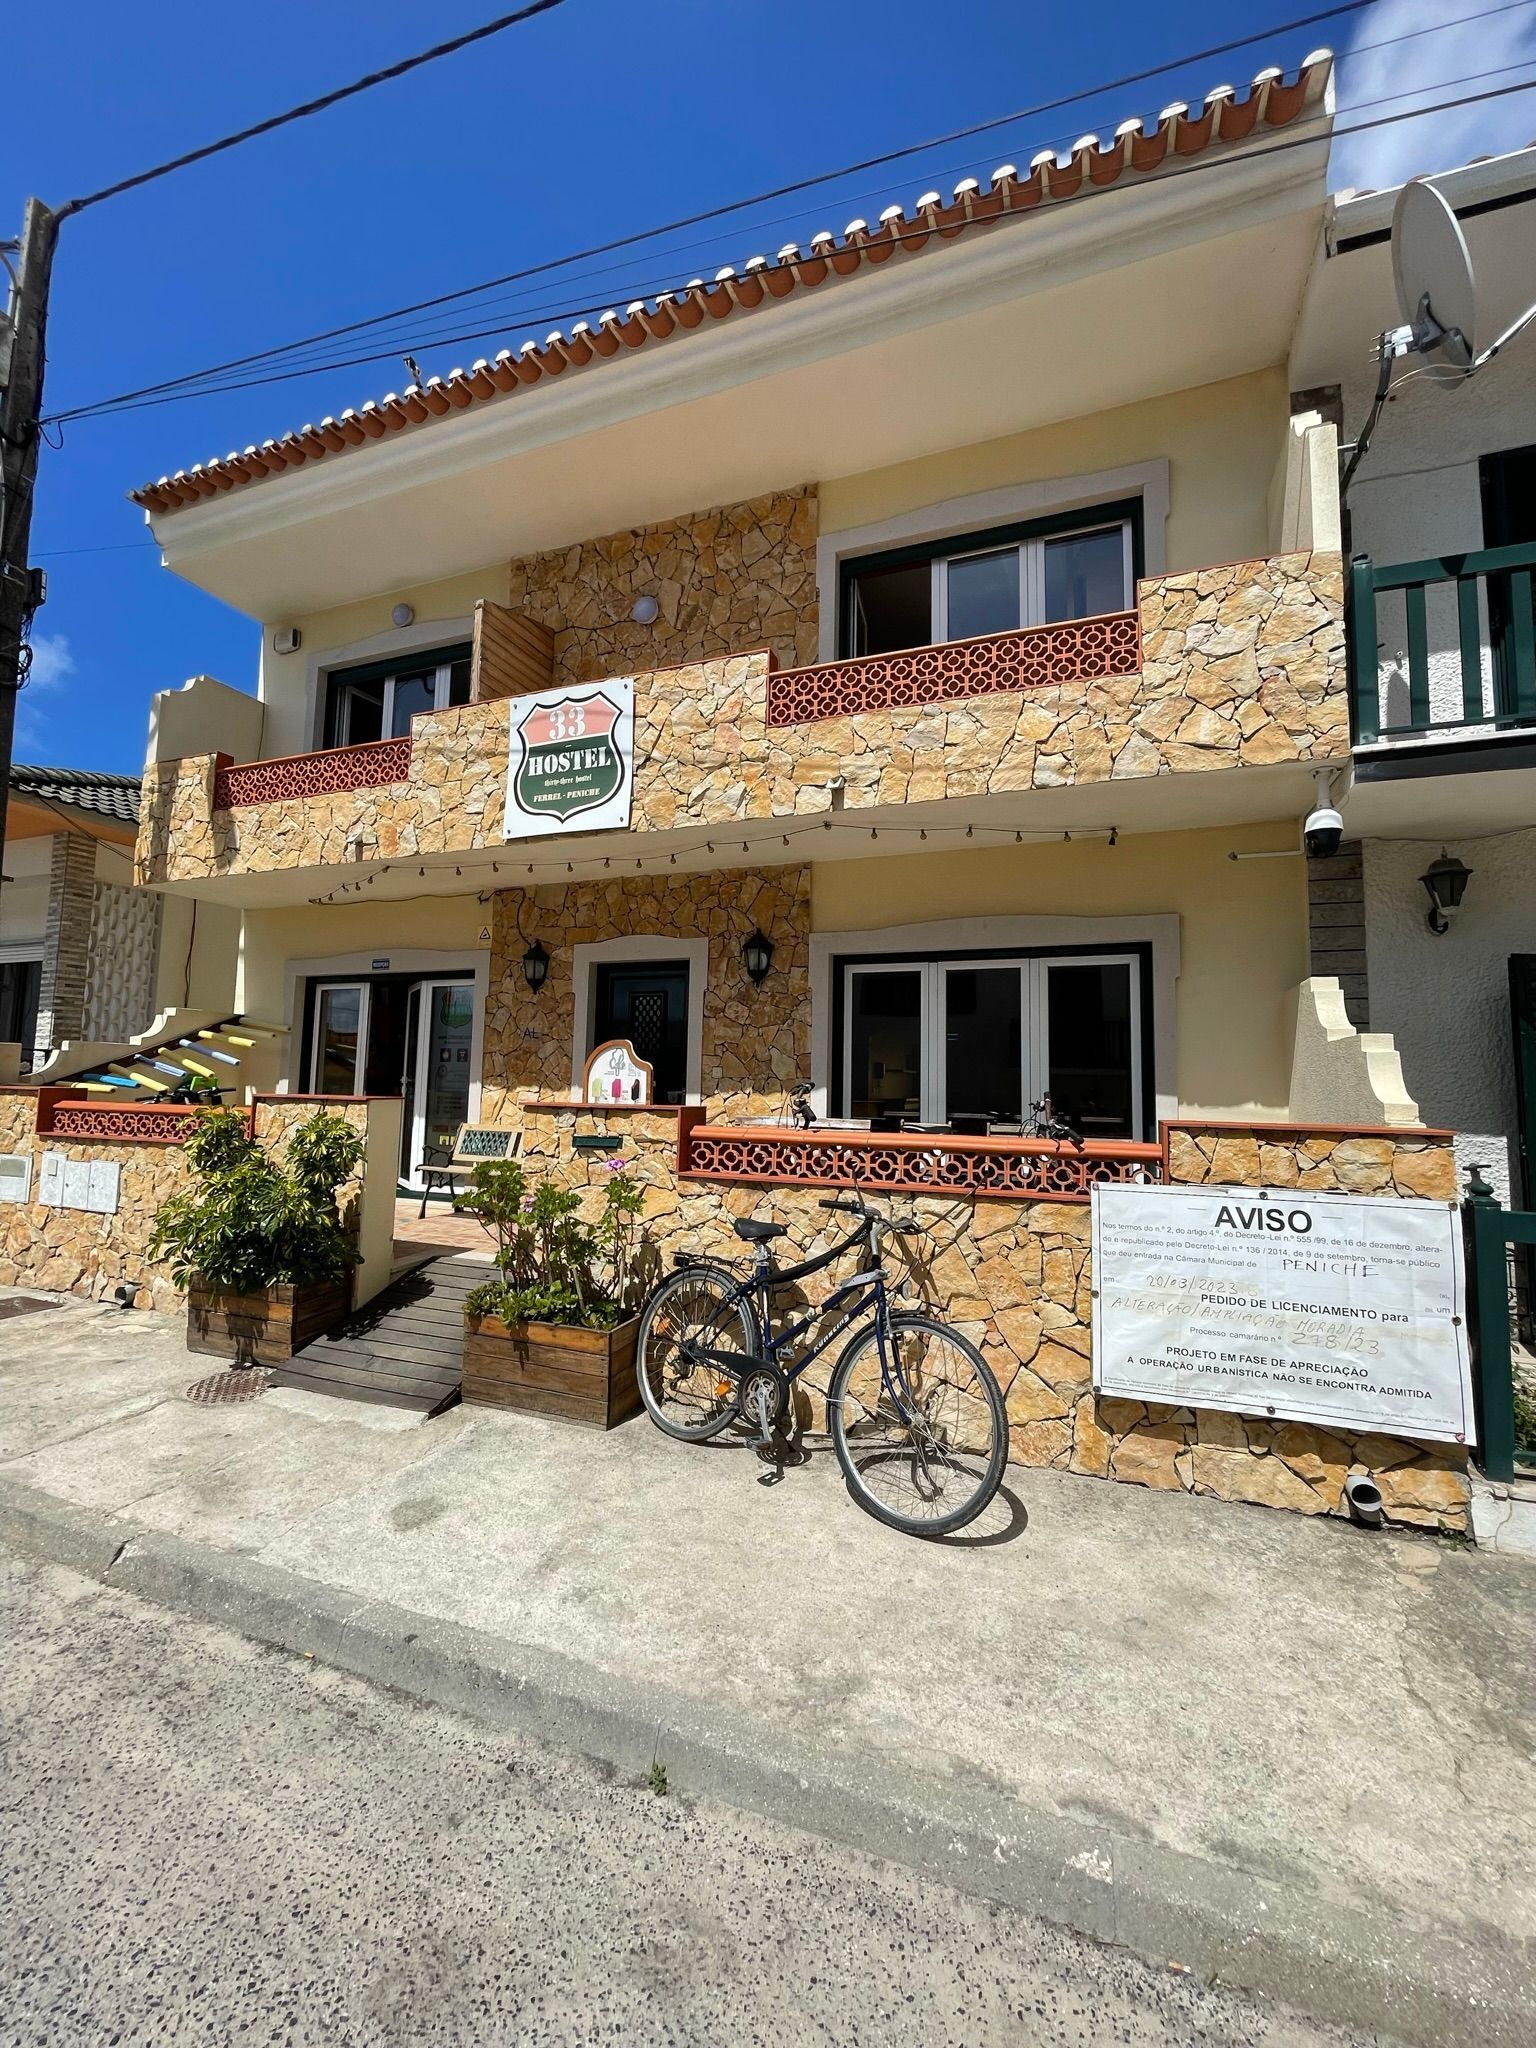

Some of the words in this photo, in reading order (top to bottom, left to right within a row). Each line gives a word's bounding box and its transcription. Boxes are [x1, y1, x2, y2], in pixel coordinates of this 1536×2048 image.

[550, 706, 586, 740] 33
[527, 747, 611, 777] HOSTEL
[533, 791, 562, 803] FERREL
[566, 787, 601, 799] PENICHE
[1214, 1205, 1313, 1234] AVISO
[1118, 1223, 1142, 1231] termos
[1175, 1227, 1186, 1235] do
[1187, 1228, 1208, 1237] artigo
[1223, 1230, 1234, 1238] do
[1296, 1236, 1312, 1244] 555
[1330, 1238, 1341, 1246] de
[1344, 1239, 1354, 1247] 16
[1356, 1239, 1367, 1247] de
[1369, 1241, 1413, 1252] dezembro,
[1415, 1244, 1443, 1254] altera-
[1120, 1237, 1164, 1247] republicado
[1166, 1240, 1183, 1248] pelo
[1246, 1246, 1261, 1254] 136
[1293, 1250, 1304, 1258] de
[1306, 1250, 1312, 1258] 9
[1313, 1251, 1325, 1259] de
[1327, 1252, 1369, 1264] setembro,
[1370, 1255, 1406, 1266] torna-se
[1408, 1259, 1441, 1269] público
[1102, 1249, 1117, 1257] que
[1133, 1251, 1162, 1260] entrada
[1175, 1254, 1206, 1264] Câmara
[1207, 1256, 1245, 1268] Municipal
[1246, 1260, 1257, 1268] de
[1282, 1258, 1380, 1278] PENICHE
[1201, 1293, 1247, 1307] PEDIDO
[1250, 1298, 1267, 1309] DE
[1272, 1300, 1378, 1320] LICENCIAMENTO
[1381, 1312, 1409, 1323] para
[1189, 1326, 1227, 1338] Processo
[1229, 1331, 1269, 1342] camarário
[1166, 1346, 1217, 1360] PROJETO
[1220, 1352, 1237, 1363] EM
[1239, 1355, 1268, 1366] FASE
[1271, 1358, 1286, 1368] DE
[1289, 1360, 1369, 1378] APRECIAÇÃO
[1127, 1356, 1135, 1364] A
[1139, 1358, 1194, 1371] OPERAÇÃO
[1197, 1364, 1269, 1380] URBANÍSTICA
[1272, 1372, 1296, 1383] NÃO
[1298, 1376, 1313, 1386] SE
[1316, 1378, 1376, 1394] ENCONTRA
[1379, 1386, 1433, 1400] ADMITIDA
